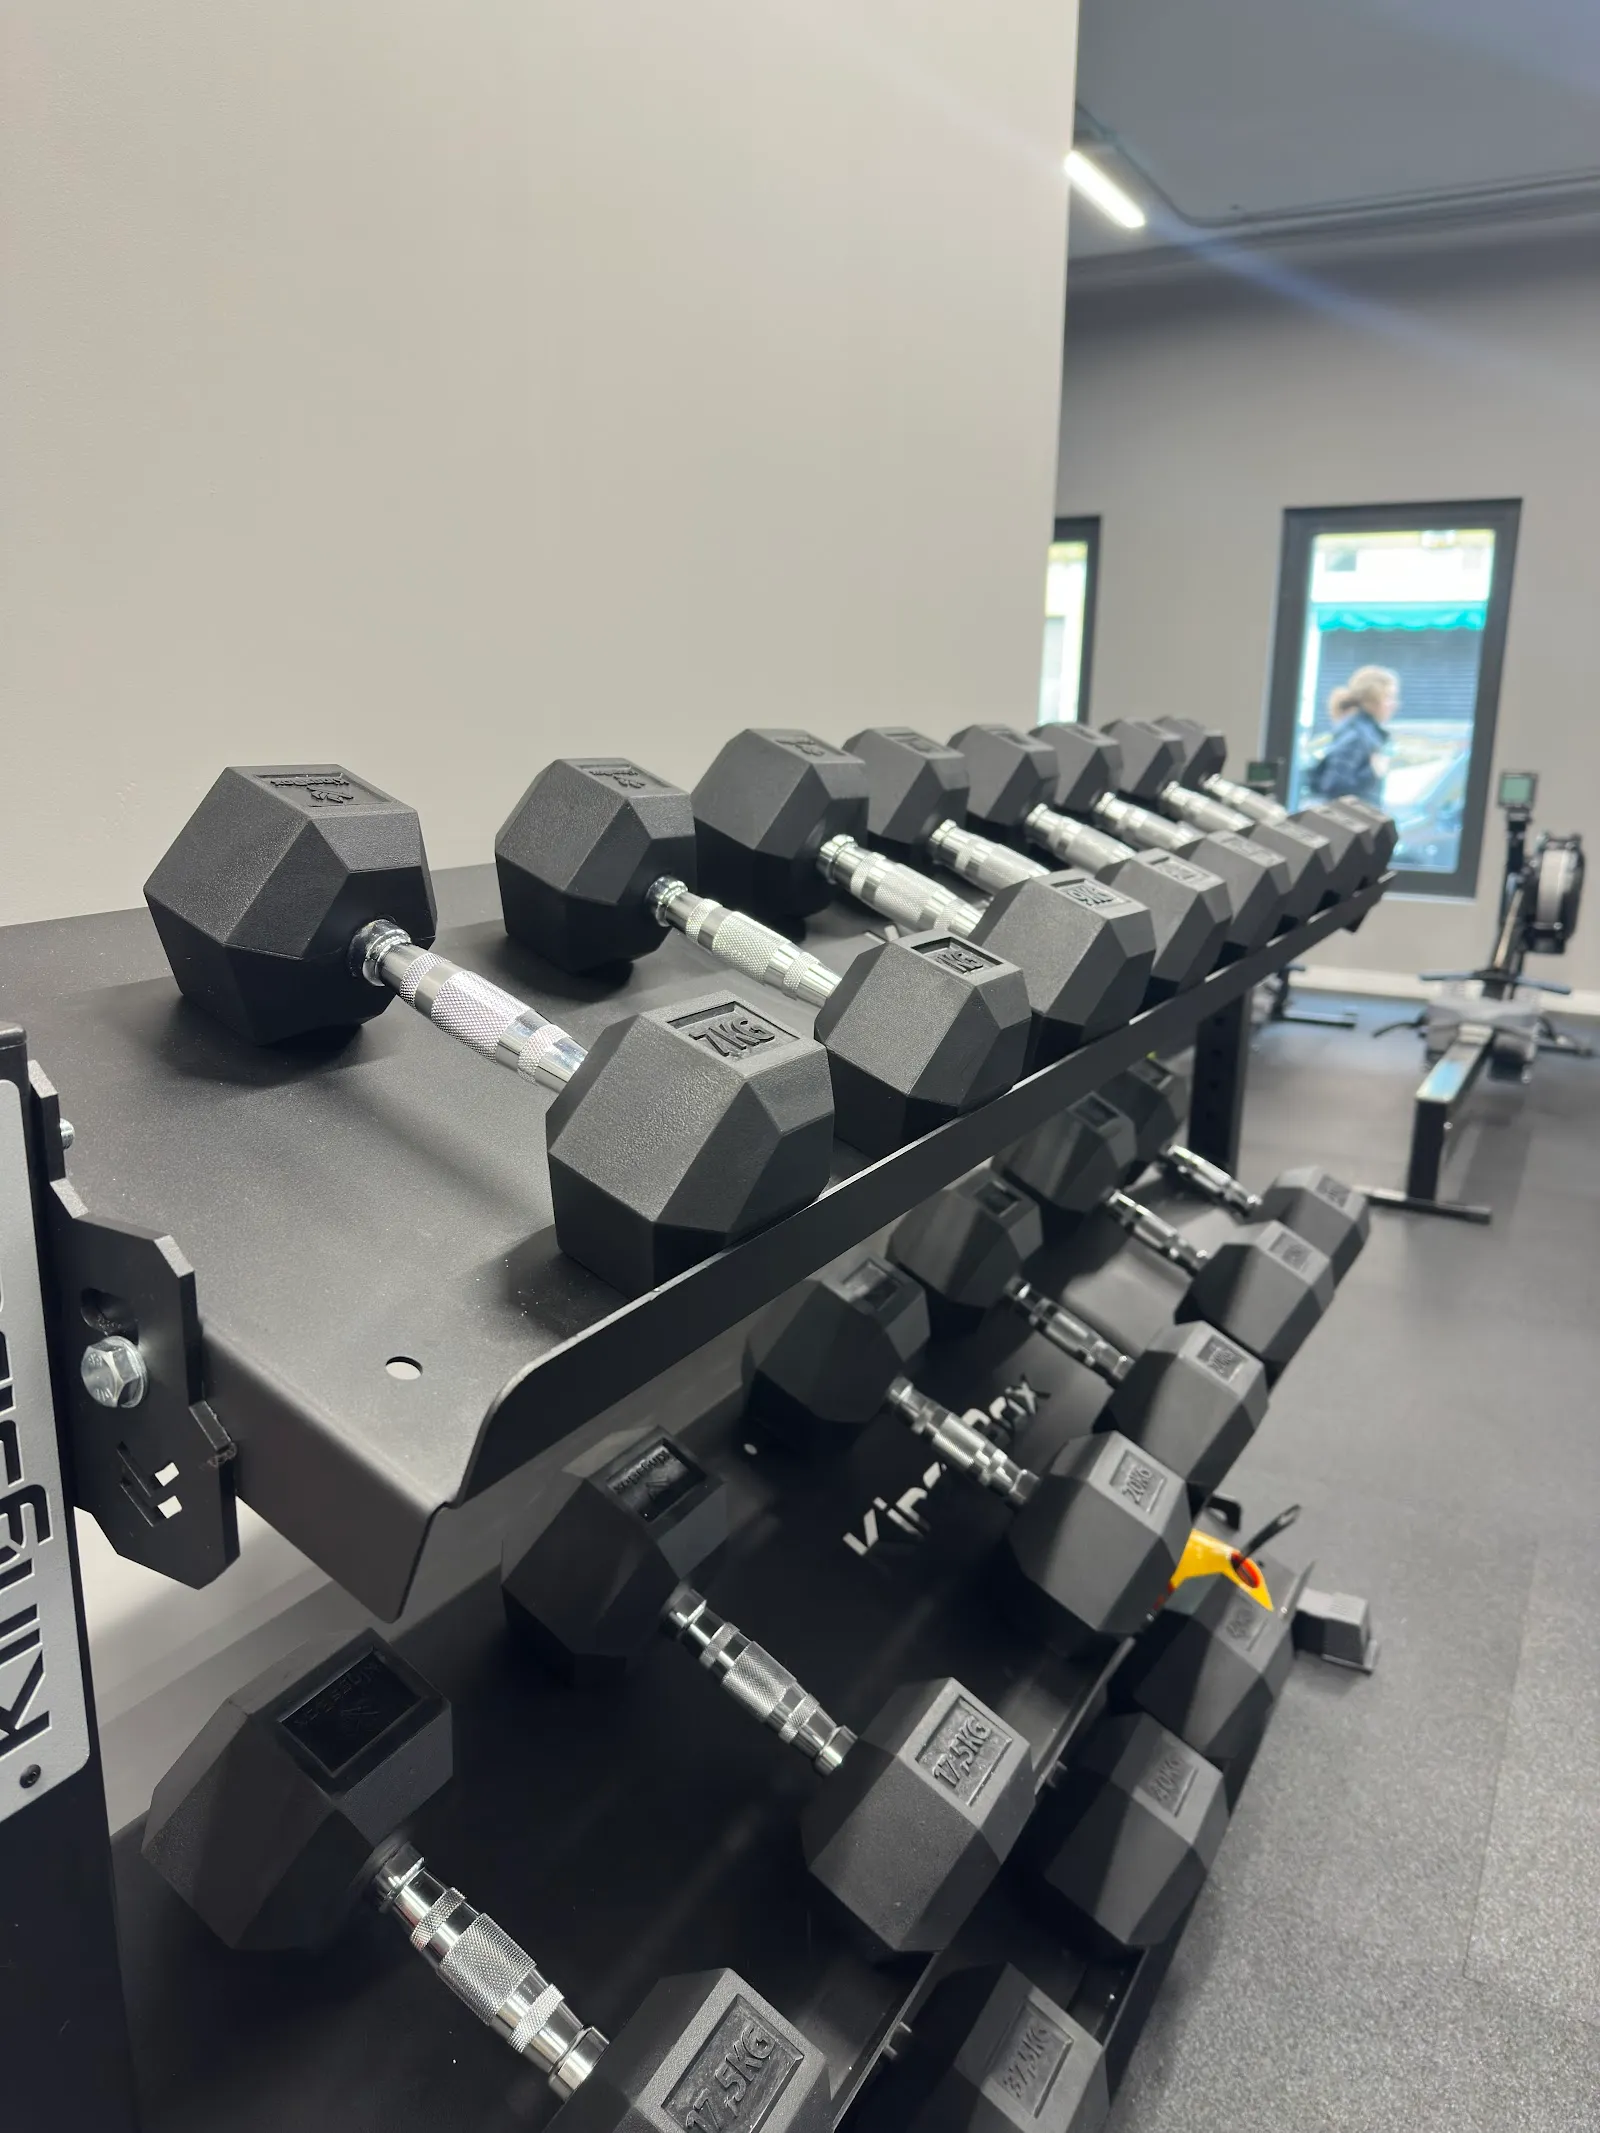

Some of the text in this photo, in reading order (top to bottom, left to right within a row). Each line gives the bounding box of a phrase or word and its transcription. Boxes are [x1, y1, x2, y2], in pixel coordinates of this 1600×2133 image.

[688, 1016, 776, 1058] 7KG
[1121, 1465, 1153, 1505] 20KG
[931, 1715, 992, 1788] 17,5KG
